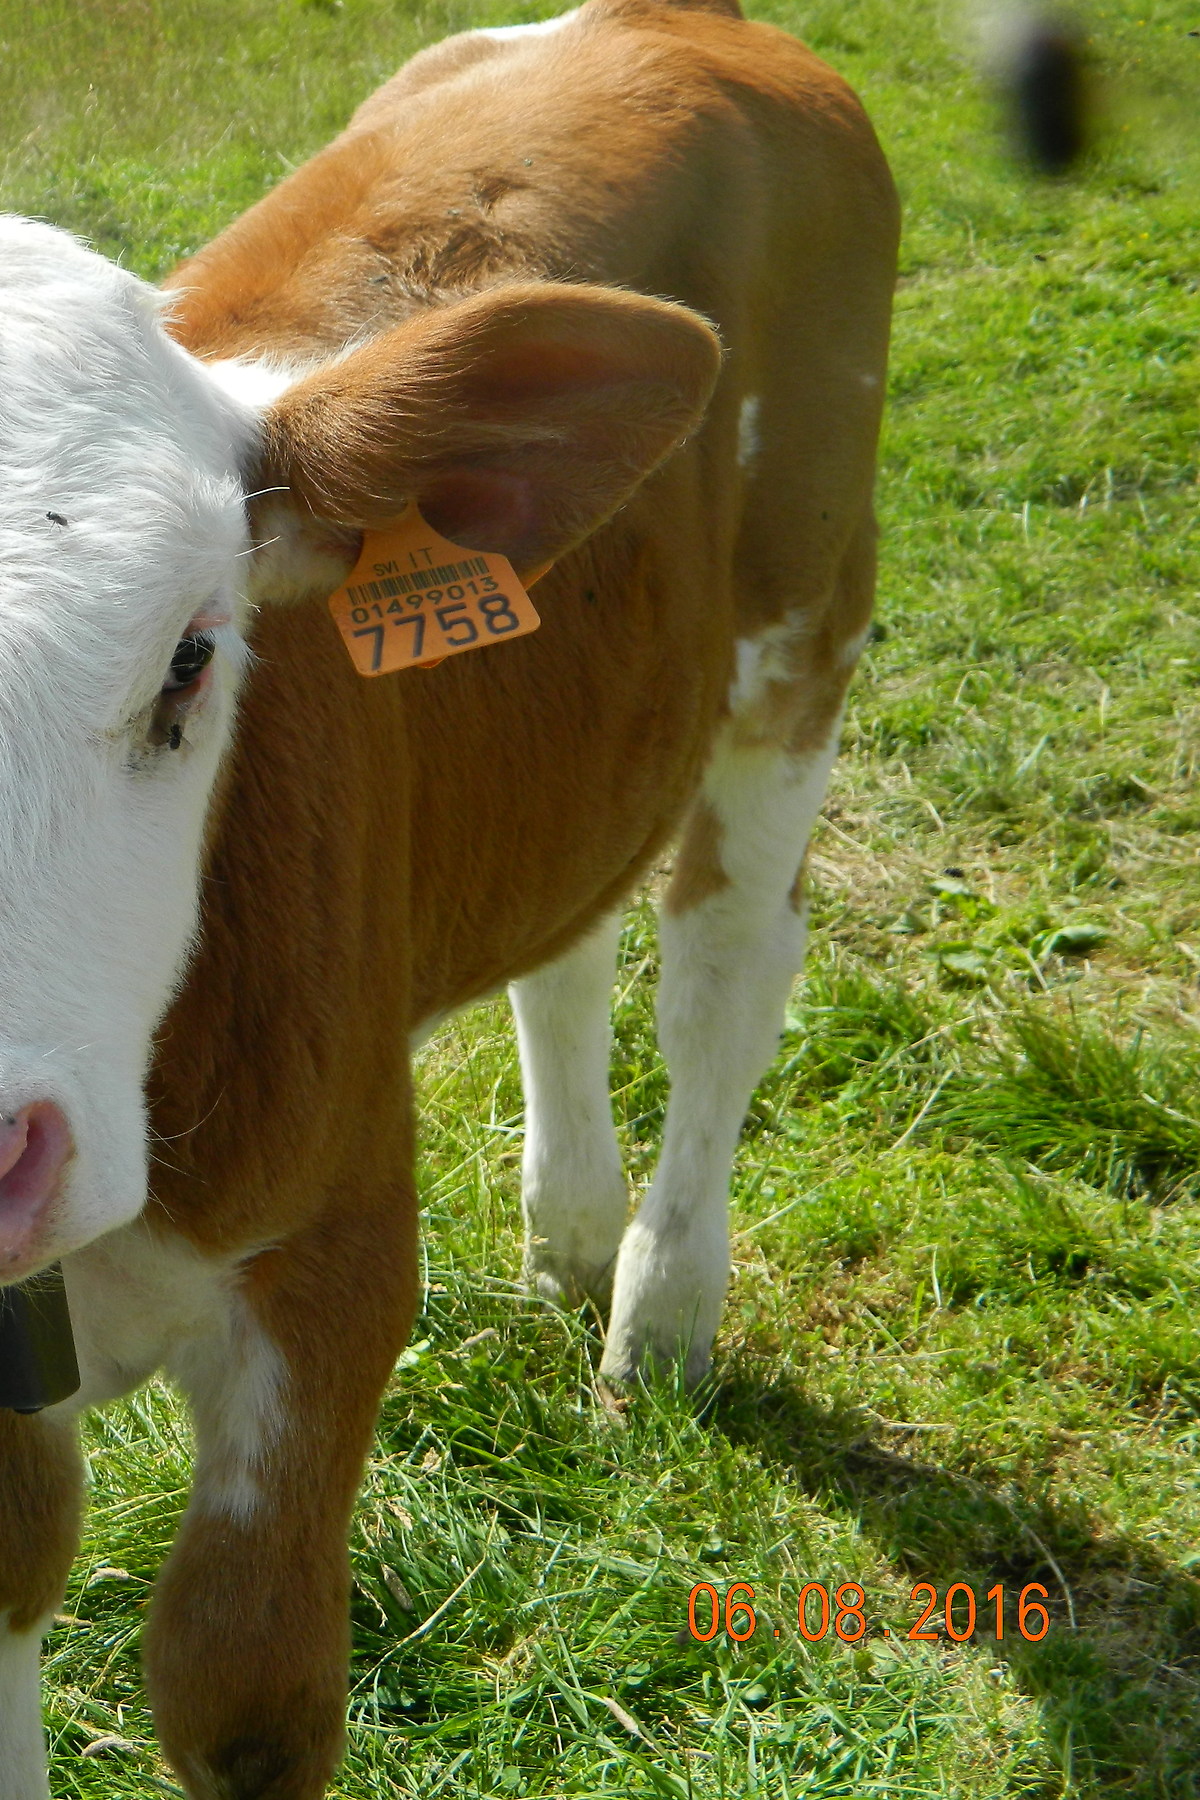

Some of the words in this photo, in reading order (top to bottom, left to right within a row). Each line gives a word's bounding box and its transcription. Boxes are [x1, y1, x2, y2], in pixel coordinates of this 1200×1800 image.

[373, 560, 399, 577] SVI
[351, 575, 499, 625] 01499013
[352, 592, 520, 671] 7758
